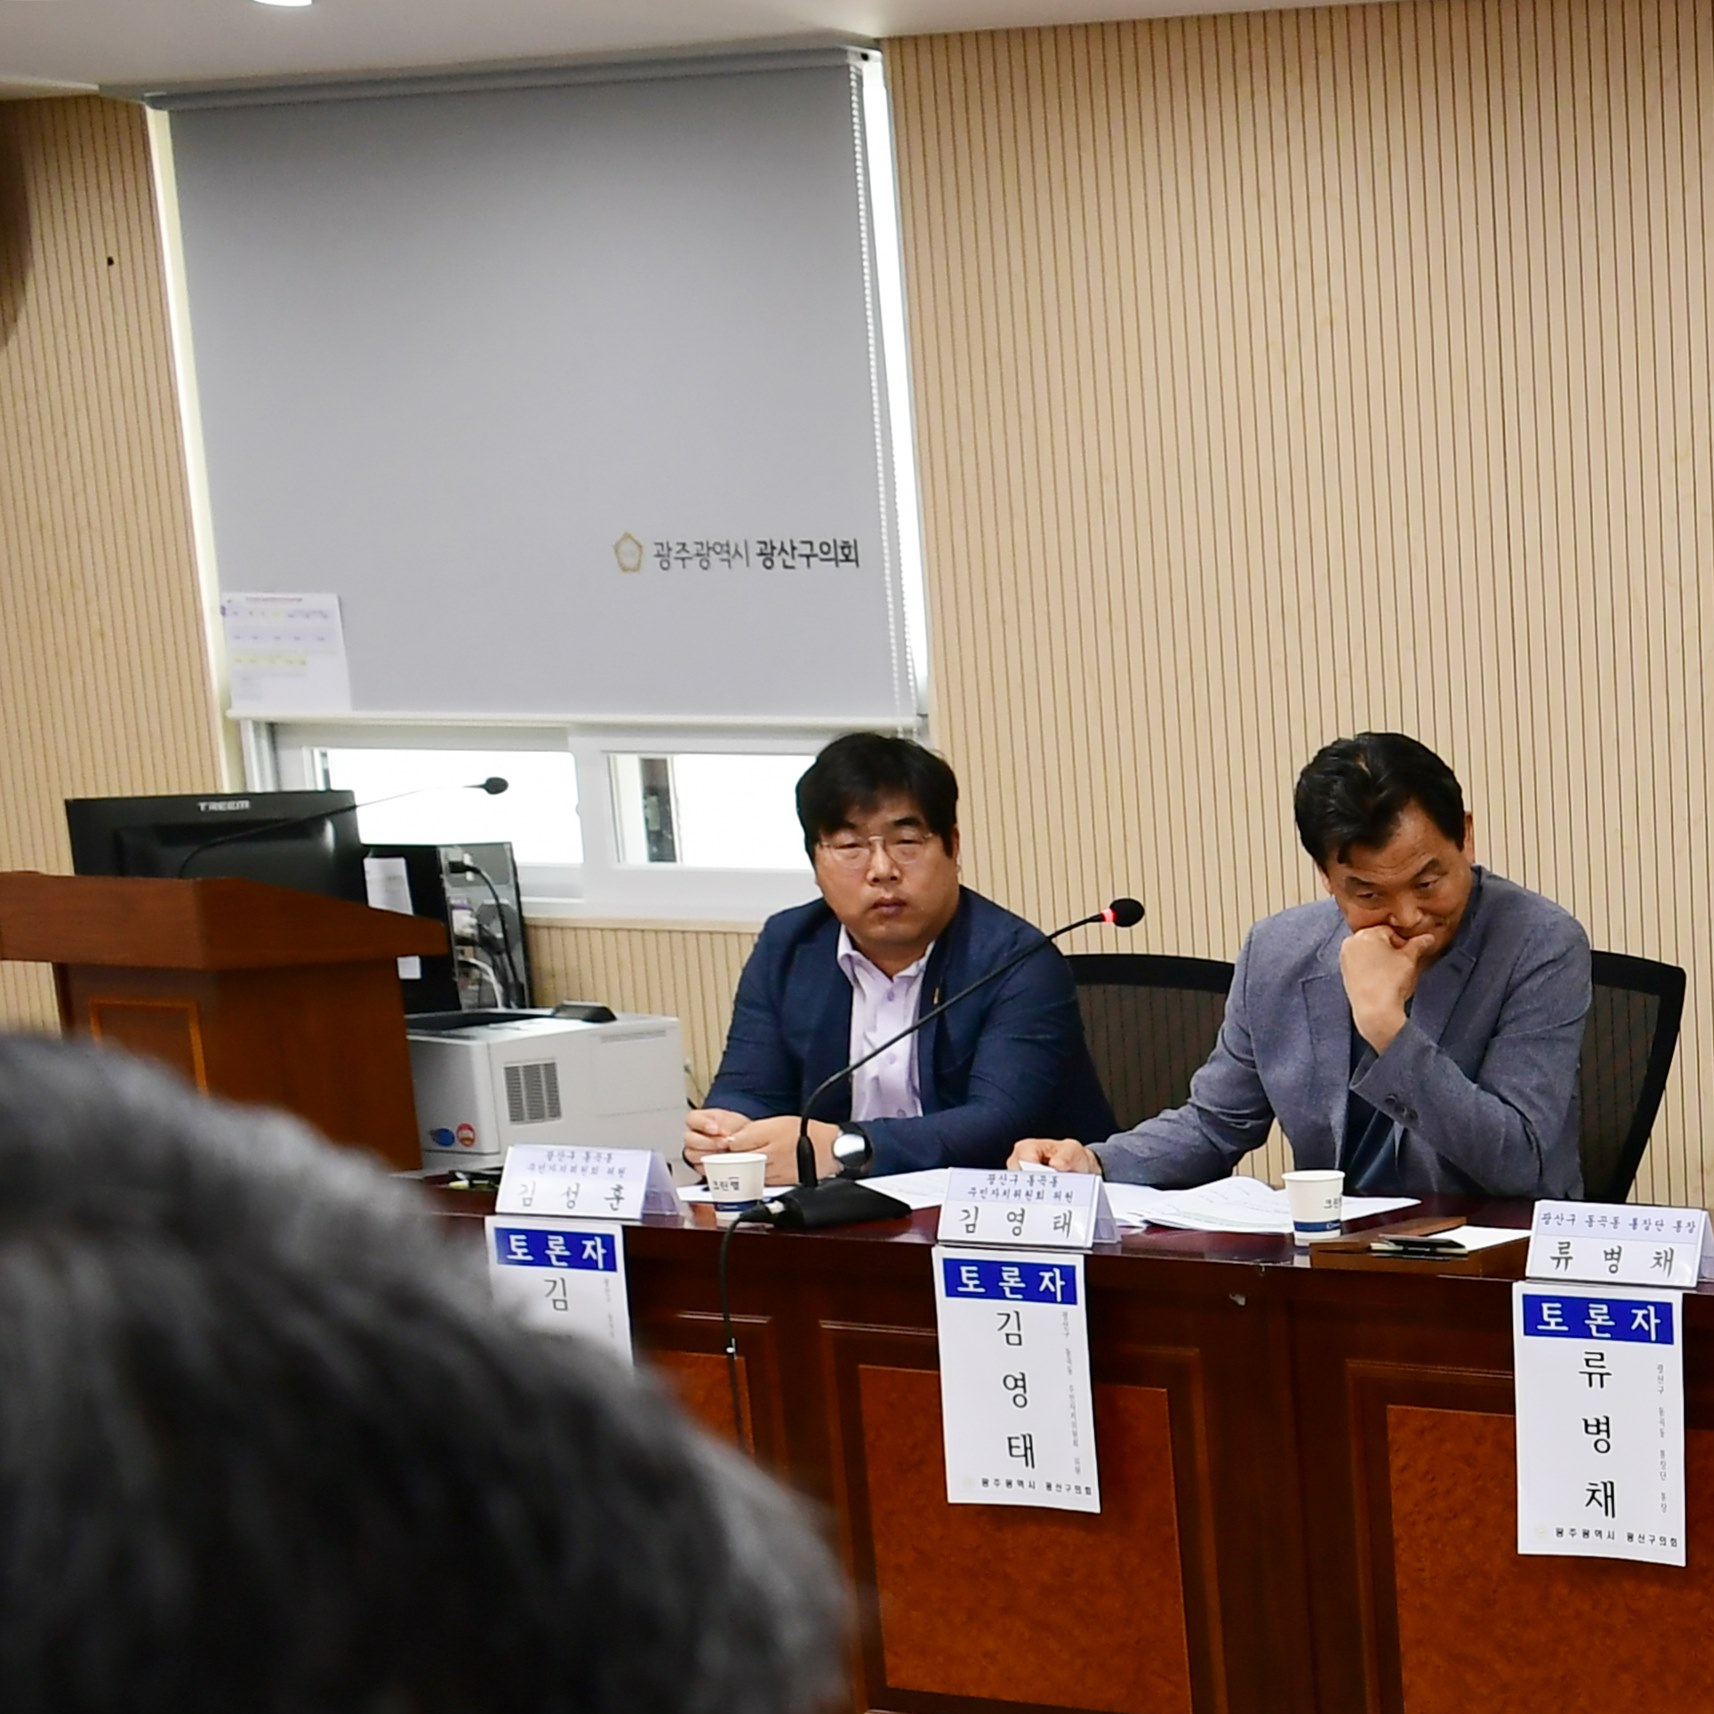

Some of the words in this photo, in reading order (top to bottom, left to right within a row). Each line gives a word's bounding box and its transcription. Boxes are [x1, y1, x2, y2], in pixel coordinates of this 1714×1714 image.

[653, 539, 750, 571] 광주광역시
[756, 538, 860, 571] 광산구의회
[959, 1205, 1073, 1239] 김영태
[1541, 1212, 1577, 1227] 광산구
[506, 1234, 607, 1270] 토론자
[1550, 1241, 1675, 1277] 류병채
[956, 1265, 1066, 1303] 토론자
[1536, 1302, 1661, 1342] 토론자
[995, 1310, 1035, 1469] 김영태
[1578, 1351, 1616, 1518] 류병채
